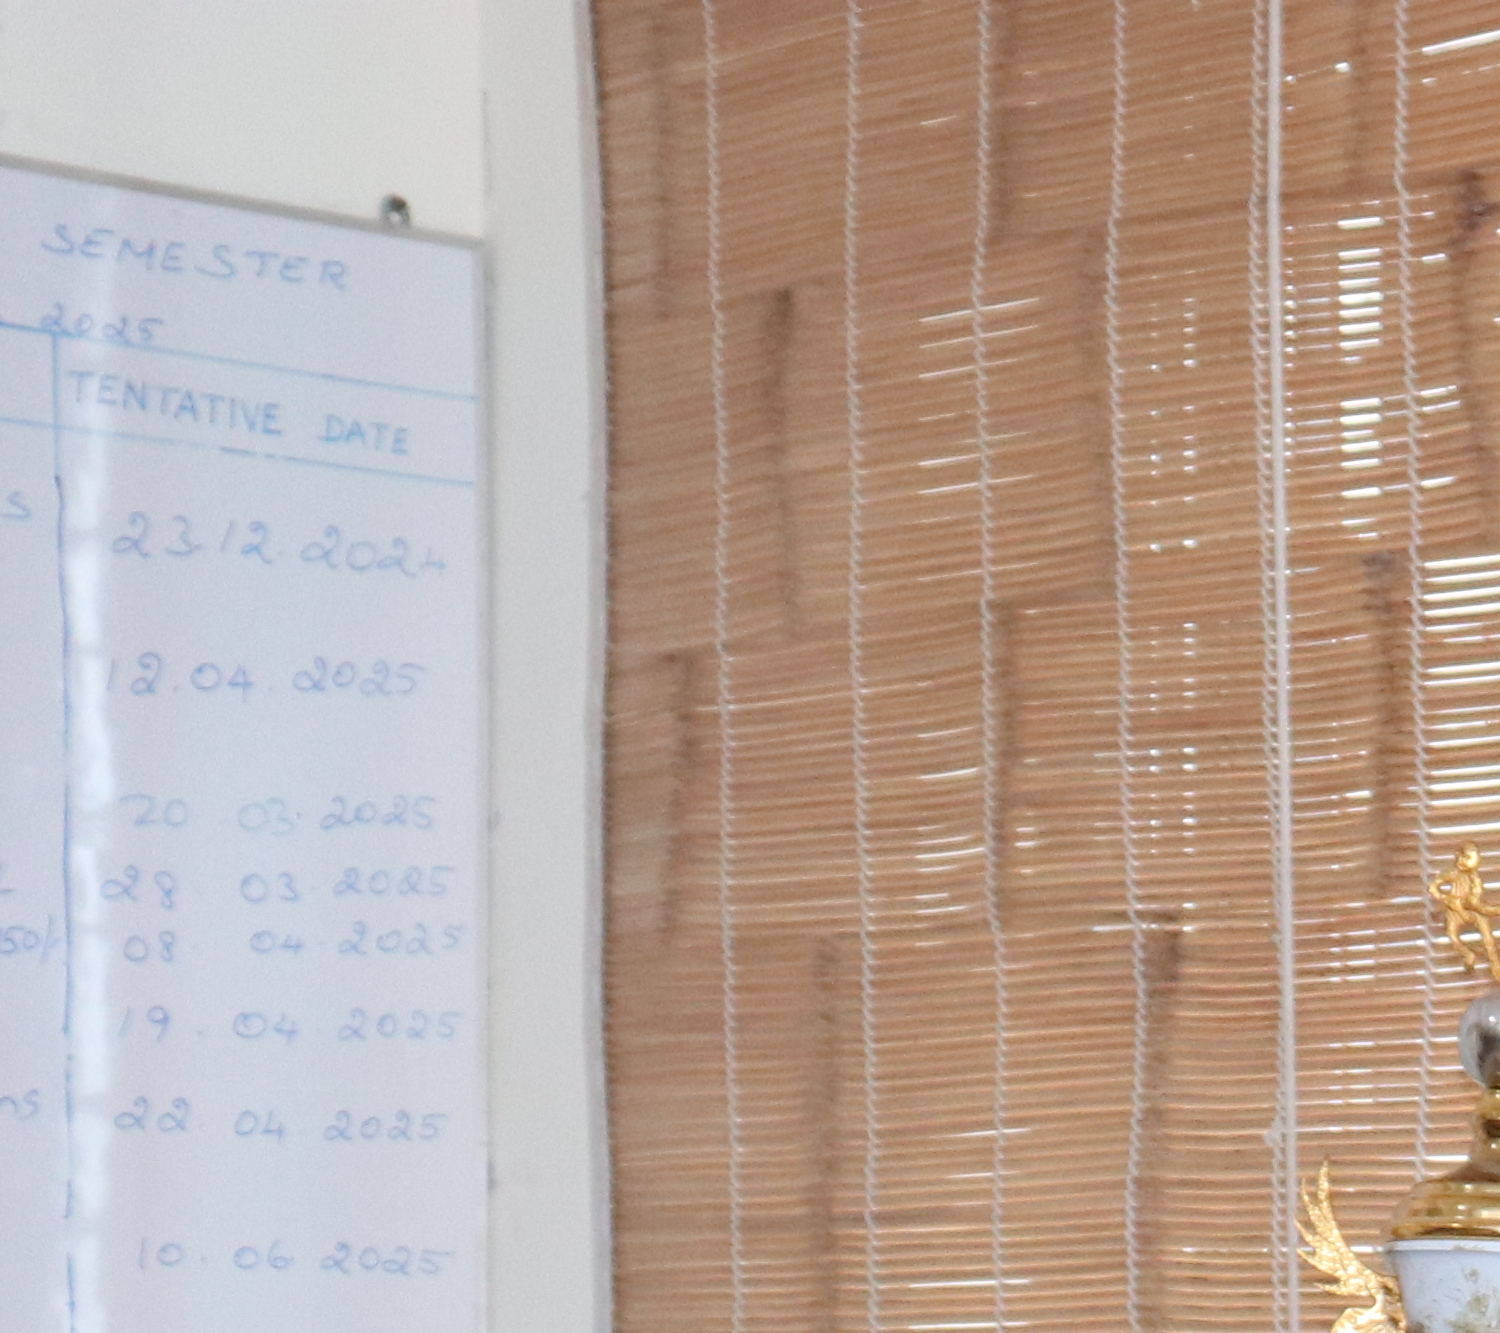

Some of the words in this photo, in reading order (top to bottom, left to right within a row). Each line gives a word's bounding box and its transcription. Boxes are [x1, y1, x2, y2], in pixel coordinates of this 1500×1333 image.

[41, 223, 348, 292] SEMESTER
[66, 370, 282, 437] TENTATIVE
[318, 413, 410, 456] DATE
